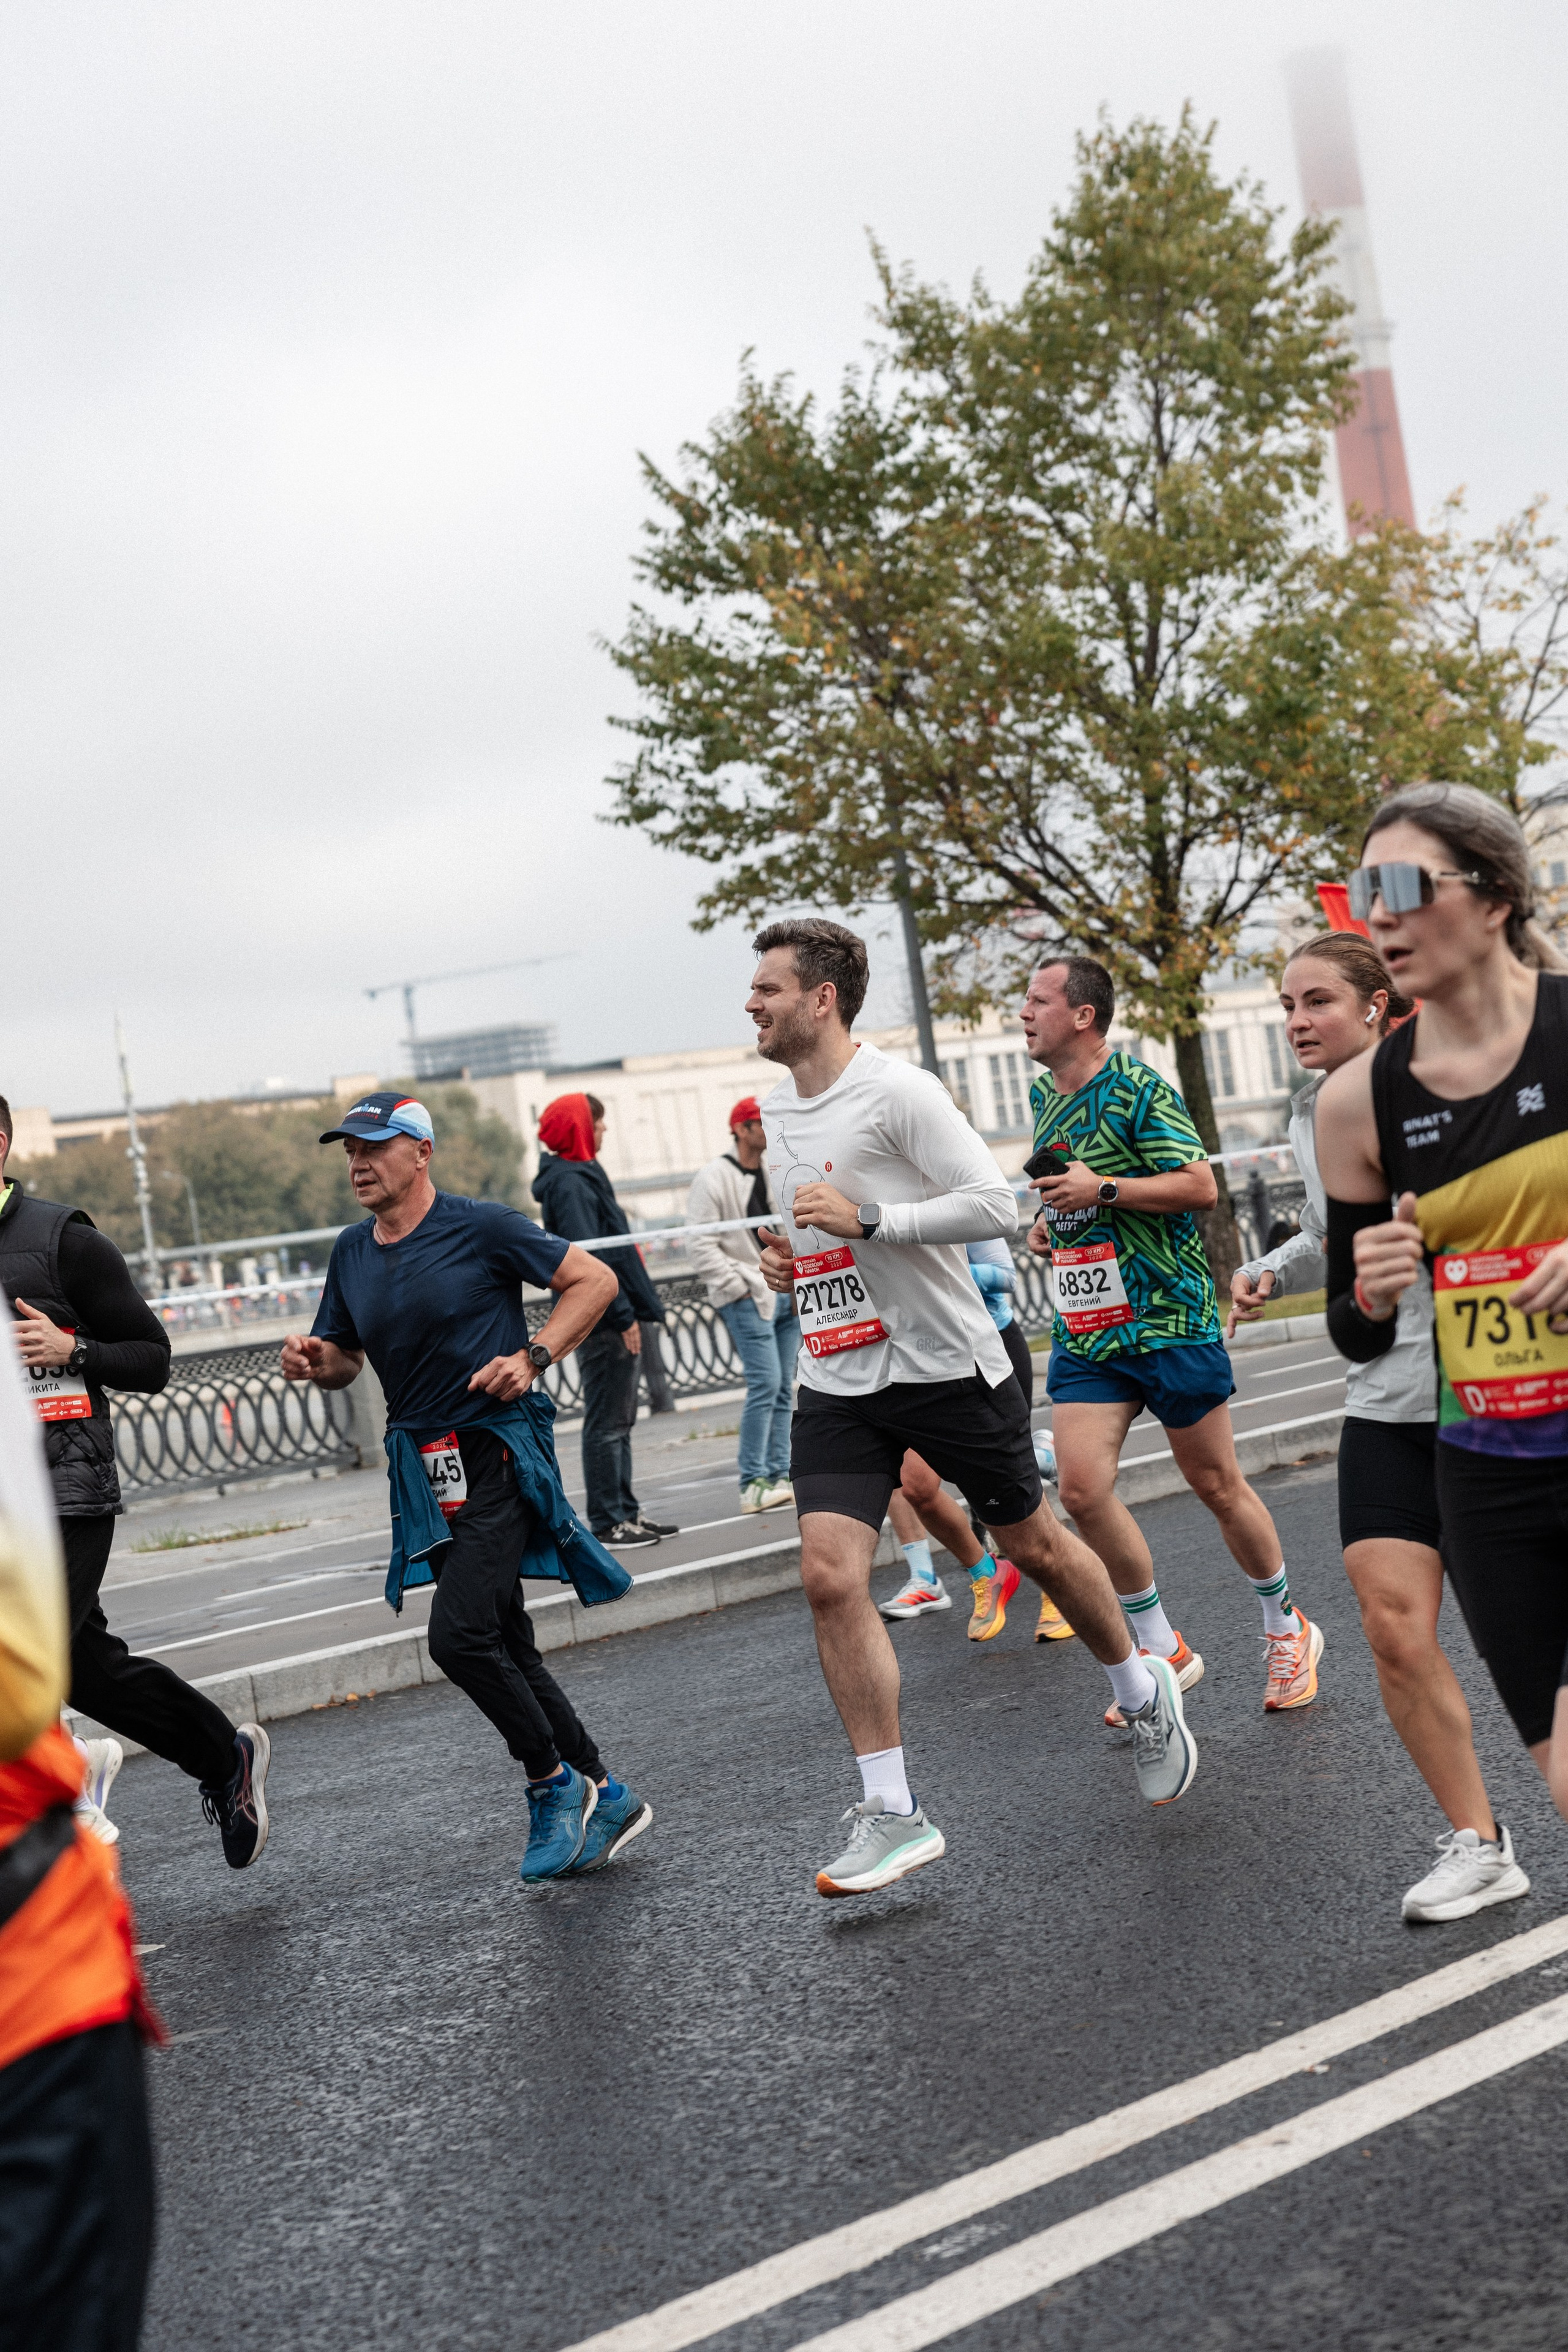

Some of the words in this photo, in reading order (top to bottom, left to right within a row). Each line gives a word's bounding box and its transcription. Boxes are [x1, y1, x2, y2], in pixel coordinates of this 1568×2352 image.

[1055, 1221, 1077, 1231] БЕГУТ
[1059, 1267, 1111, 1297] 6832
[796, 1274, 865, 1315] 27278
[1068, 1295, 1101, 1307] ЕВГЕНИЙ
[816, 1308, 858, 1325] АЛЕКСАНДР
[810, 1336, 821, 1355] D
[26, 1382, 60, 1394] ИКИТА
[432, 1487, 447, 1498] РИЙ
